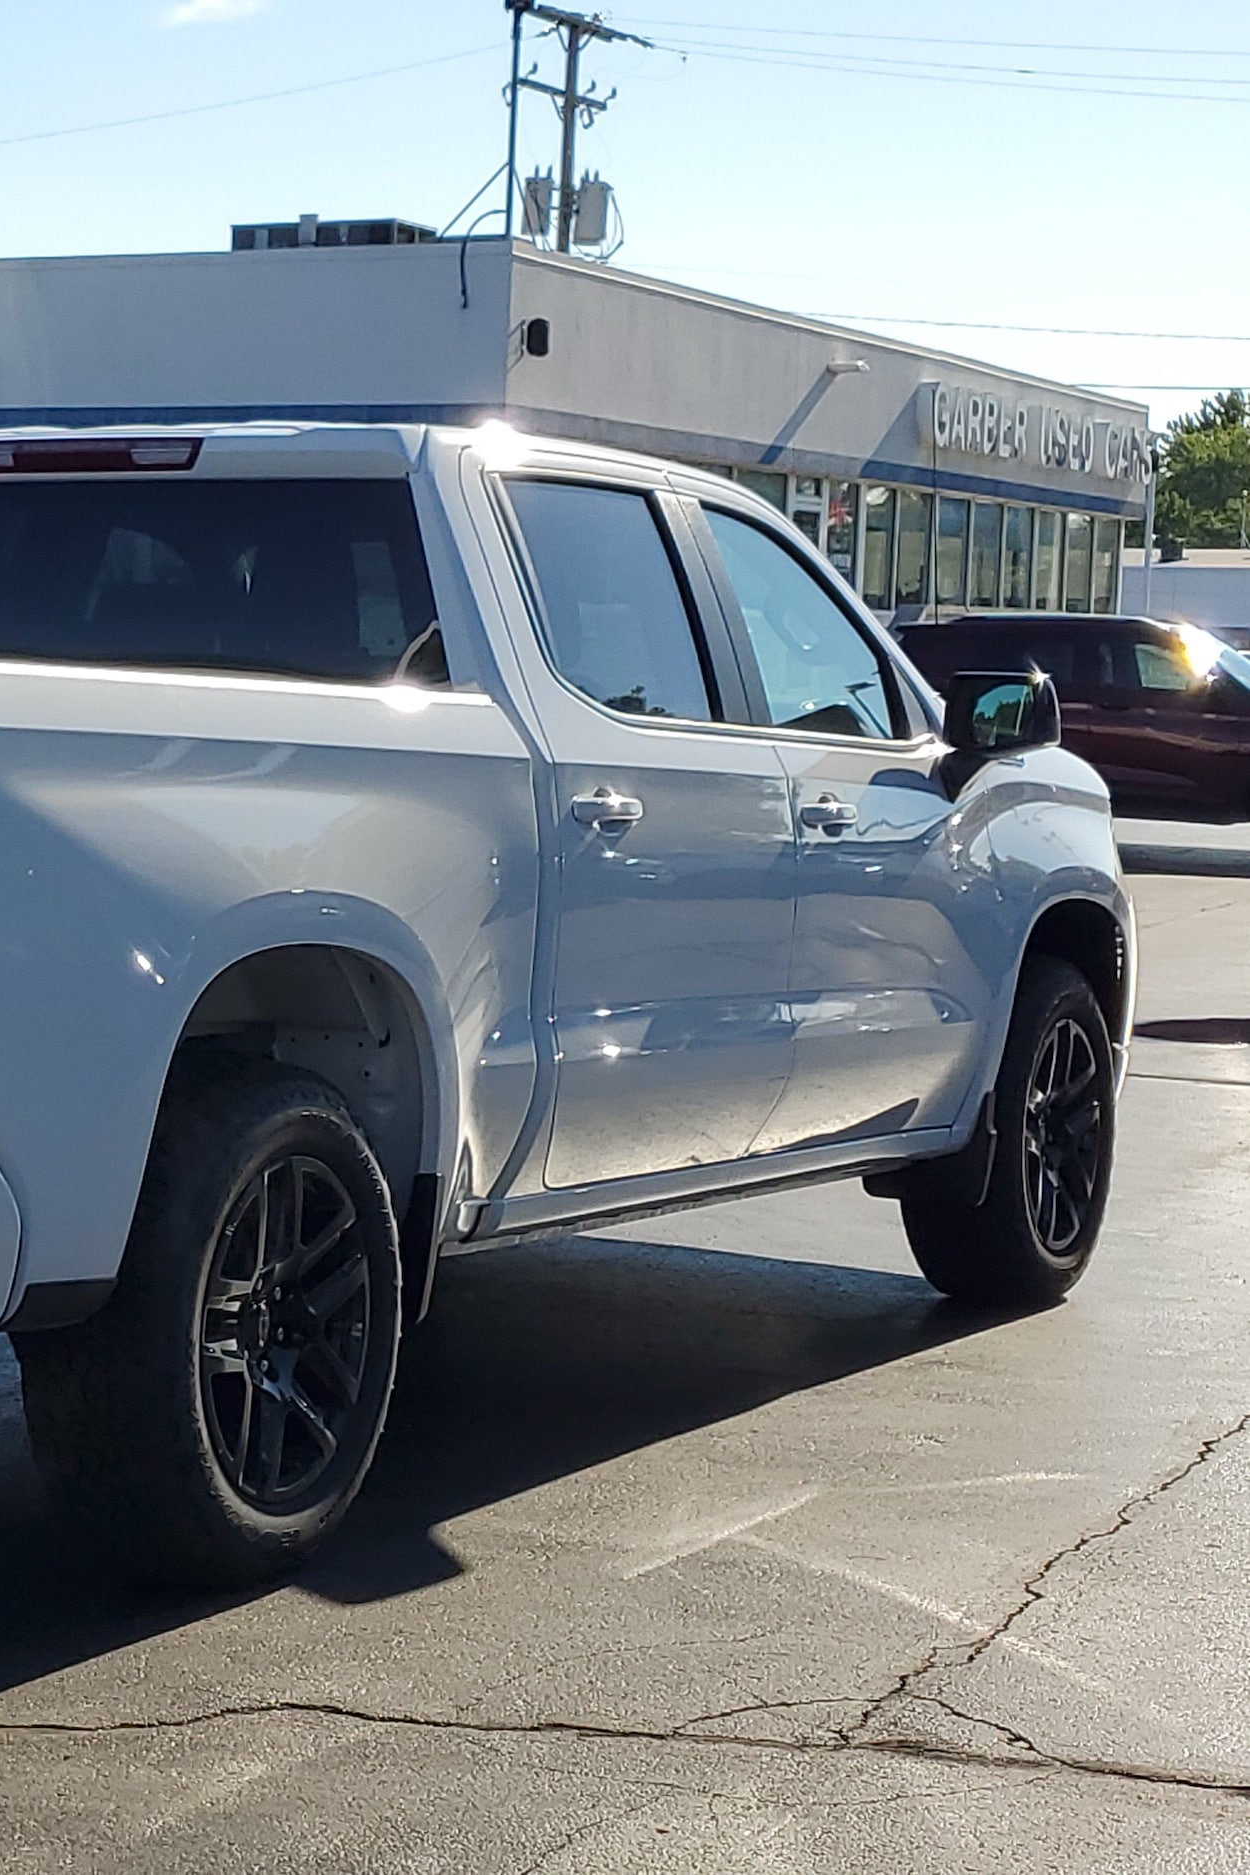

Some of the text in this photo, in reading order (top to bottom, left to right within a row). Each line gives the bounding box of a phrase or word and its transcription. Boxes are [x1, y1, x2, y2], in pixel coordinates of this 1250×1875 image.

[934, 382, 1153, 485] GARBER USED CARS
